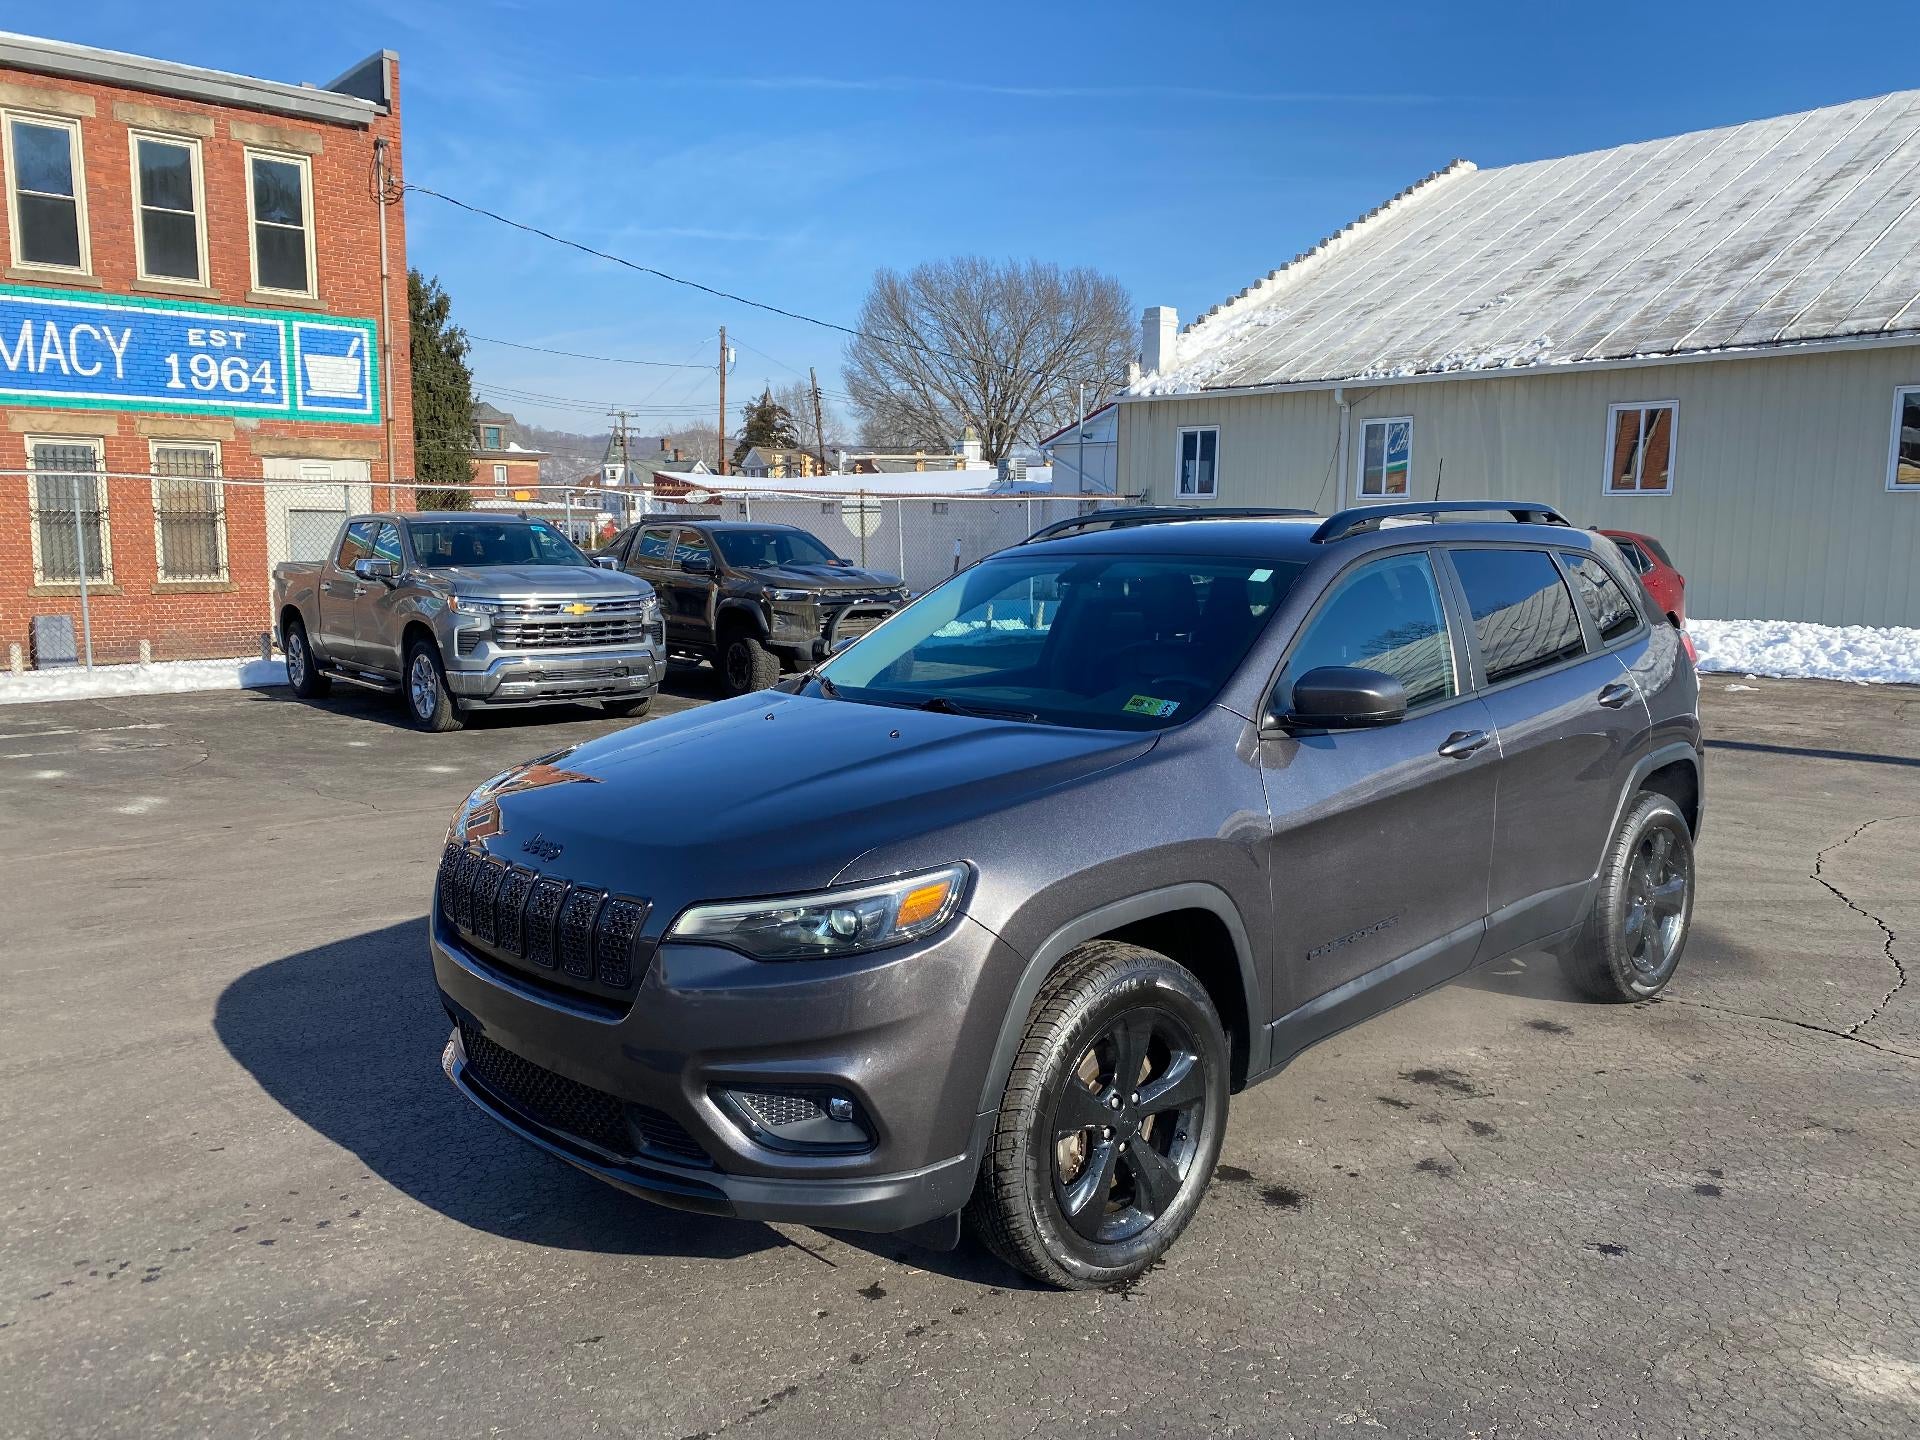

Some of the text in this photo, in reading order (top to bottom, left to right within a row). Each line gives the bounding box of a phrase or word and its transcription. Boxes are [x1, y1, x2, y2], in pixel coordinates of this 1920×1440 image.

[0, 319, 132, 379] MACY
[187, 328, 246, 350] EST
[165, 353, 277, 395] 1964
[522, 832, 564, 863] Jeep
